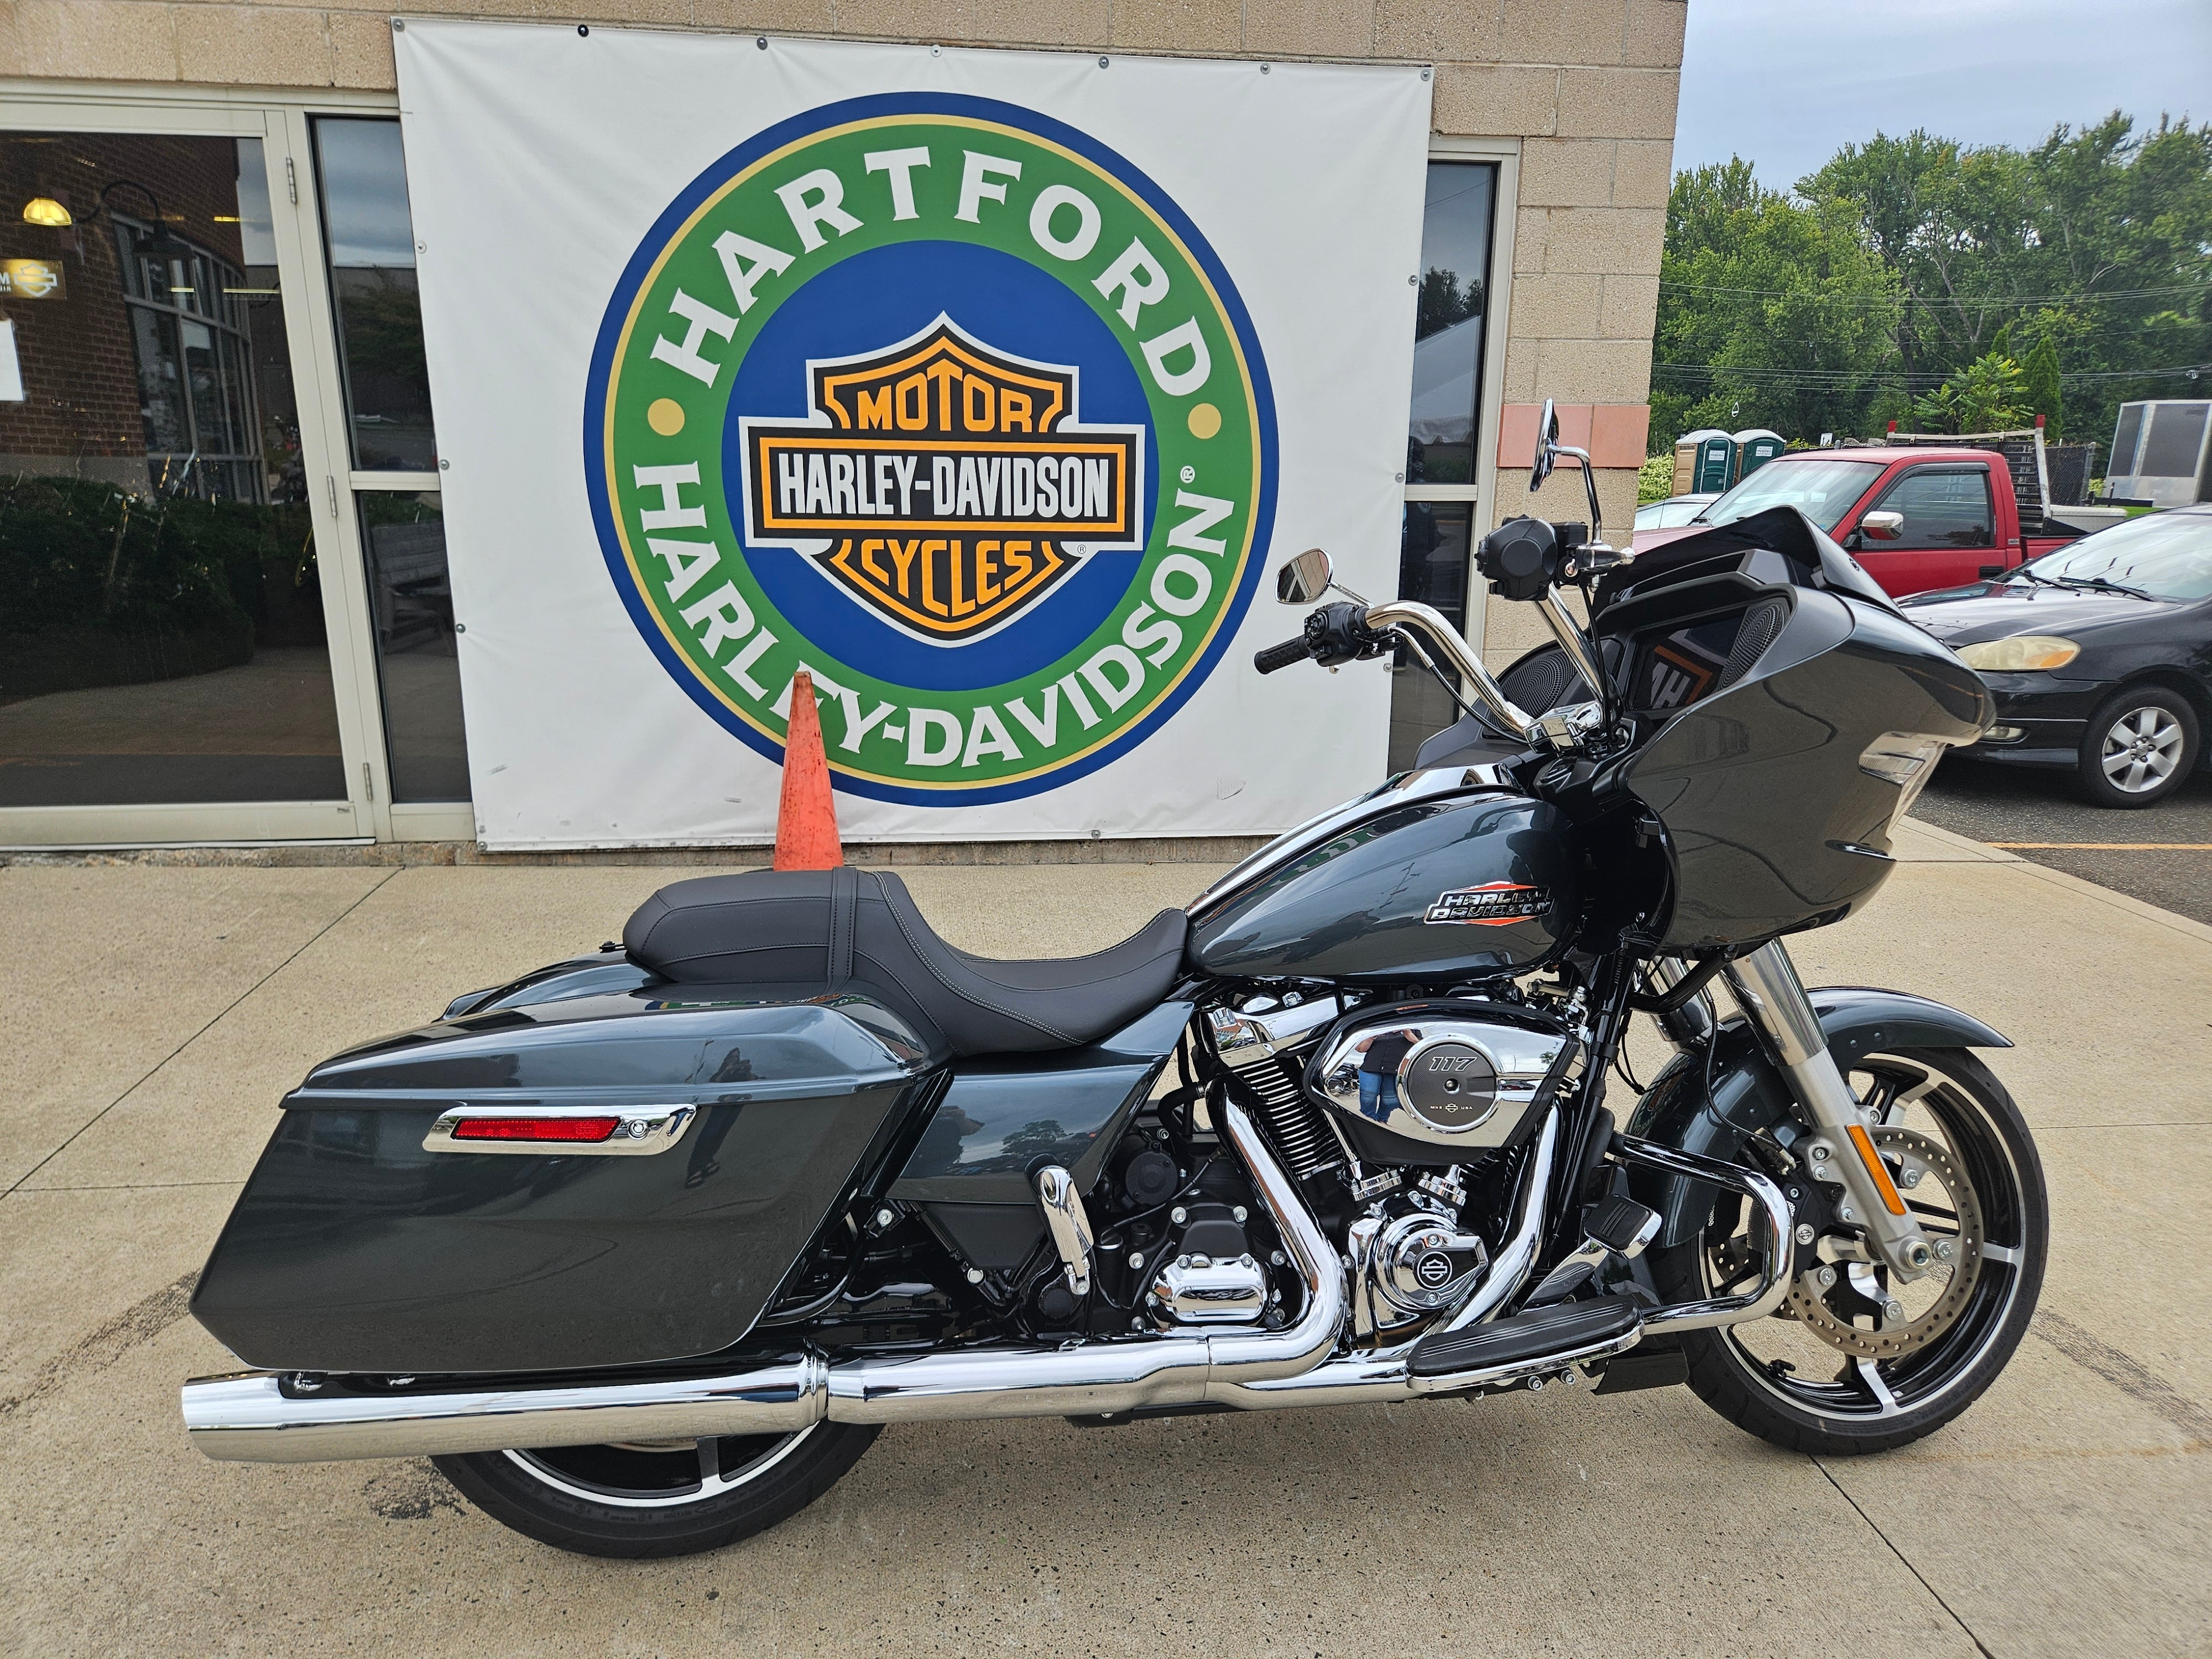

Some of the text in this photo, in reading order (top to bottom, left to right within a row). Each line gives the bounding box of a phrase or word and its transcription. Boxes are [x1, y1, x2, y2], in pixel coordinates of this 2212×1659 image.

[649, 146, 1211, 397] HARTFORD
[858, 360, 1032, 432] MOTOR
[779, 453, 1109, 518] HARLEY-DAVIDSON
[861, 540, 1032, 617] CYCLES
[1430, 901, 1551, 920] DAVIDSON
[1428, 1056, 1478, 1072] 117
